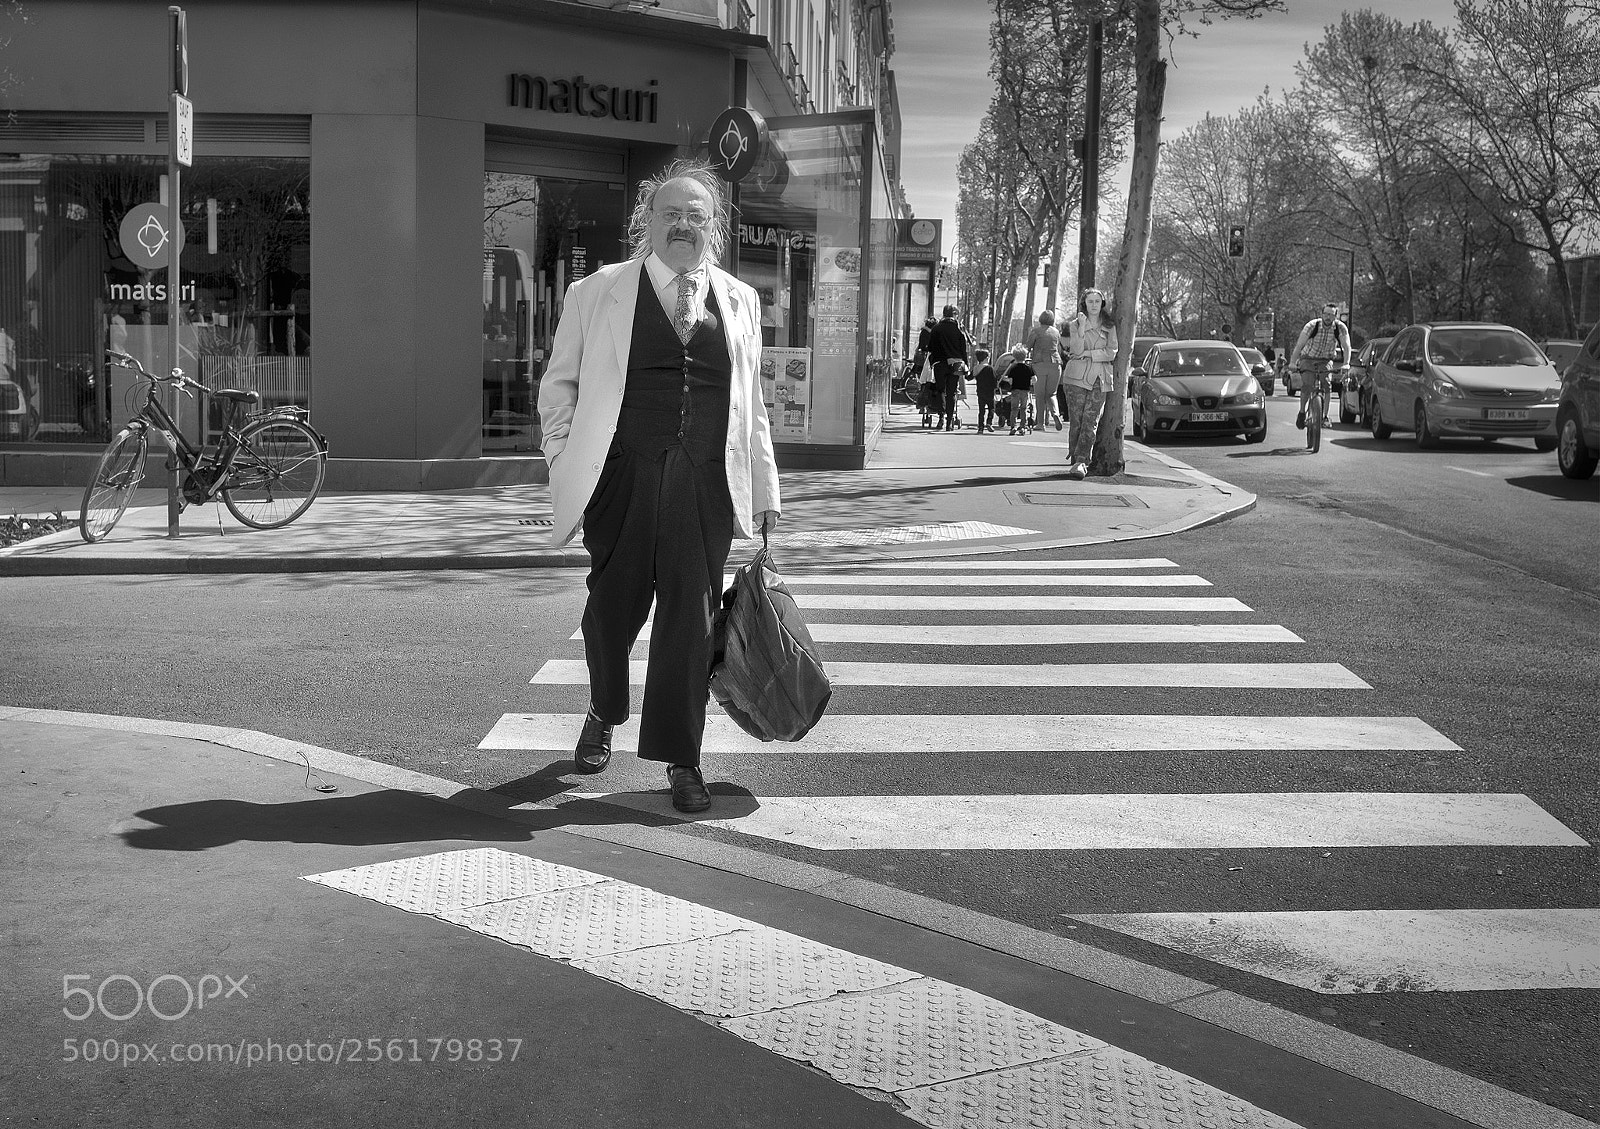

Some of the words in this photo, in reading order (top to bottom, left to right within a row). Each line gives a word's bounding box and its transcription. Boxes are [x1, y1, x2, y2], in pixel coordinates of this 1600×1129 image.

[509, 73, 658, 123] matsuri
[179, 101, 189, 118] SAUF
[110, 280, 195, 300] matsri
